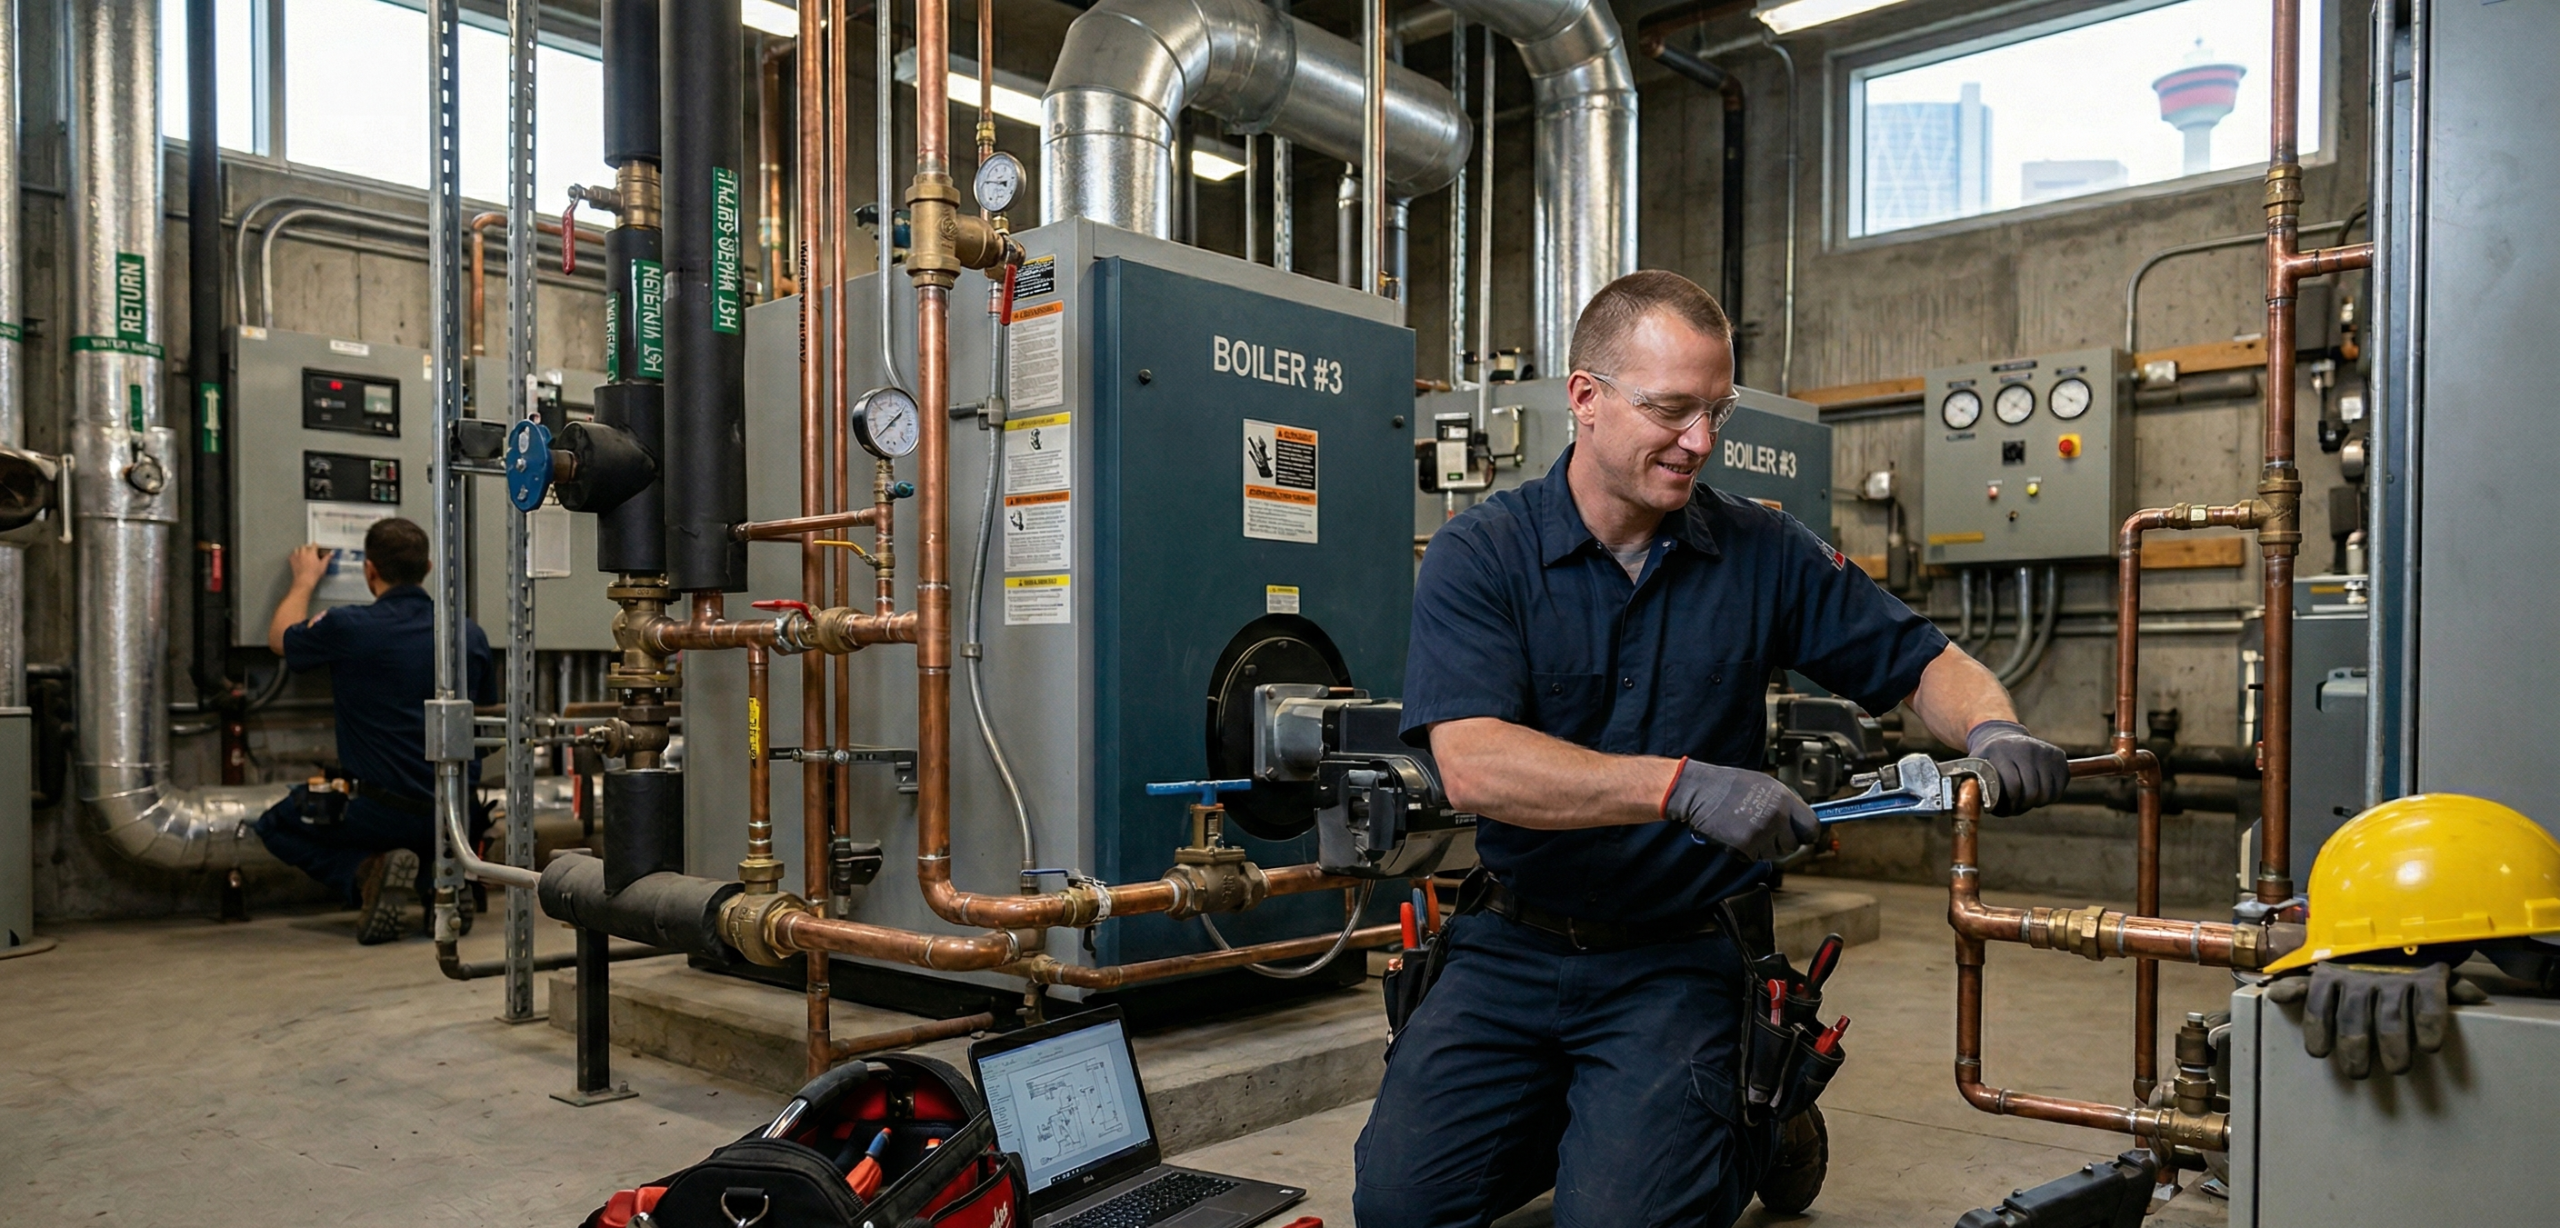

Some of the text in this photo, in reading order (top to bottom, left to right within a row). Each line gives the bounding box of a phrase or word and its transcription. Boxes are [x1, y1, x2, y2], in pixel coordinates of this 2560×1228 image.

[120, 260, 142, 333] RETURN
[1213, 334, 1343, 395] BOILER #3
[1724, 439, 1797, 479] BOILER #3
